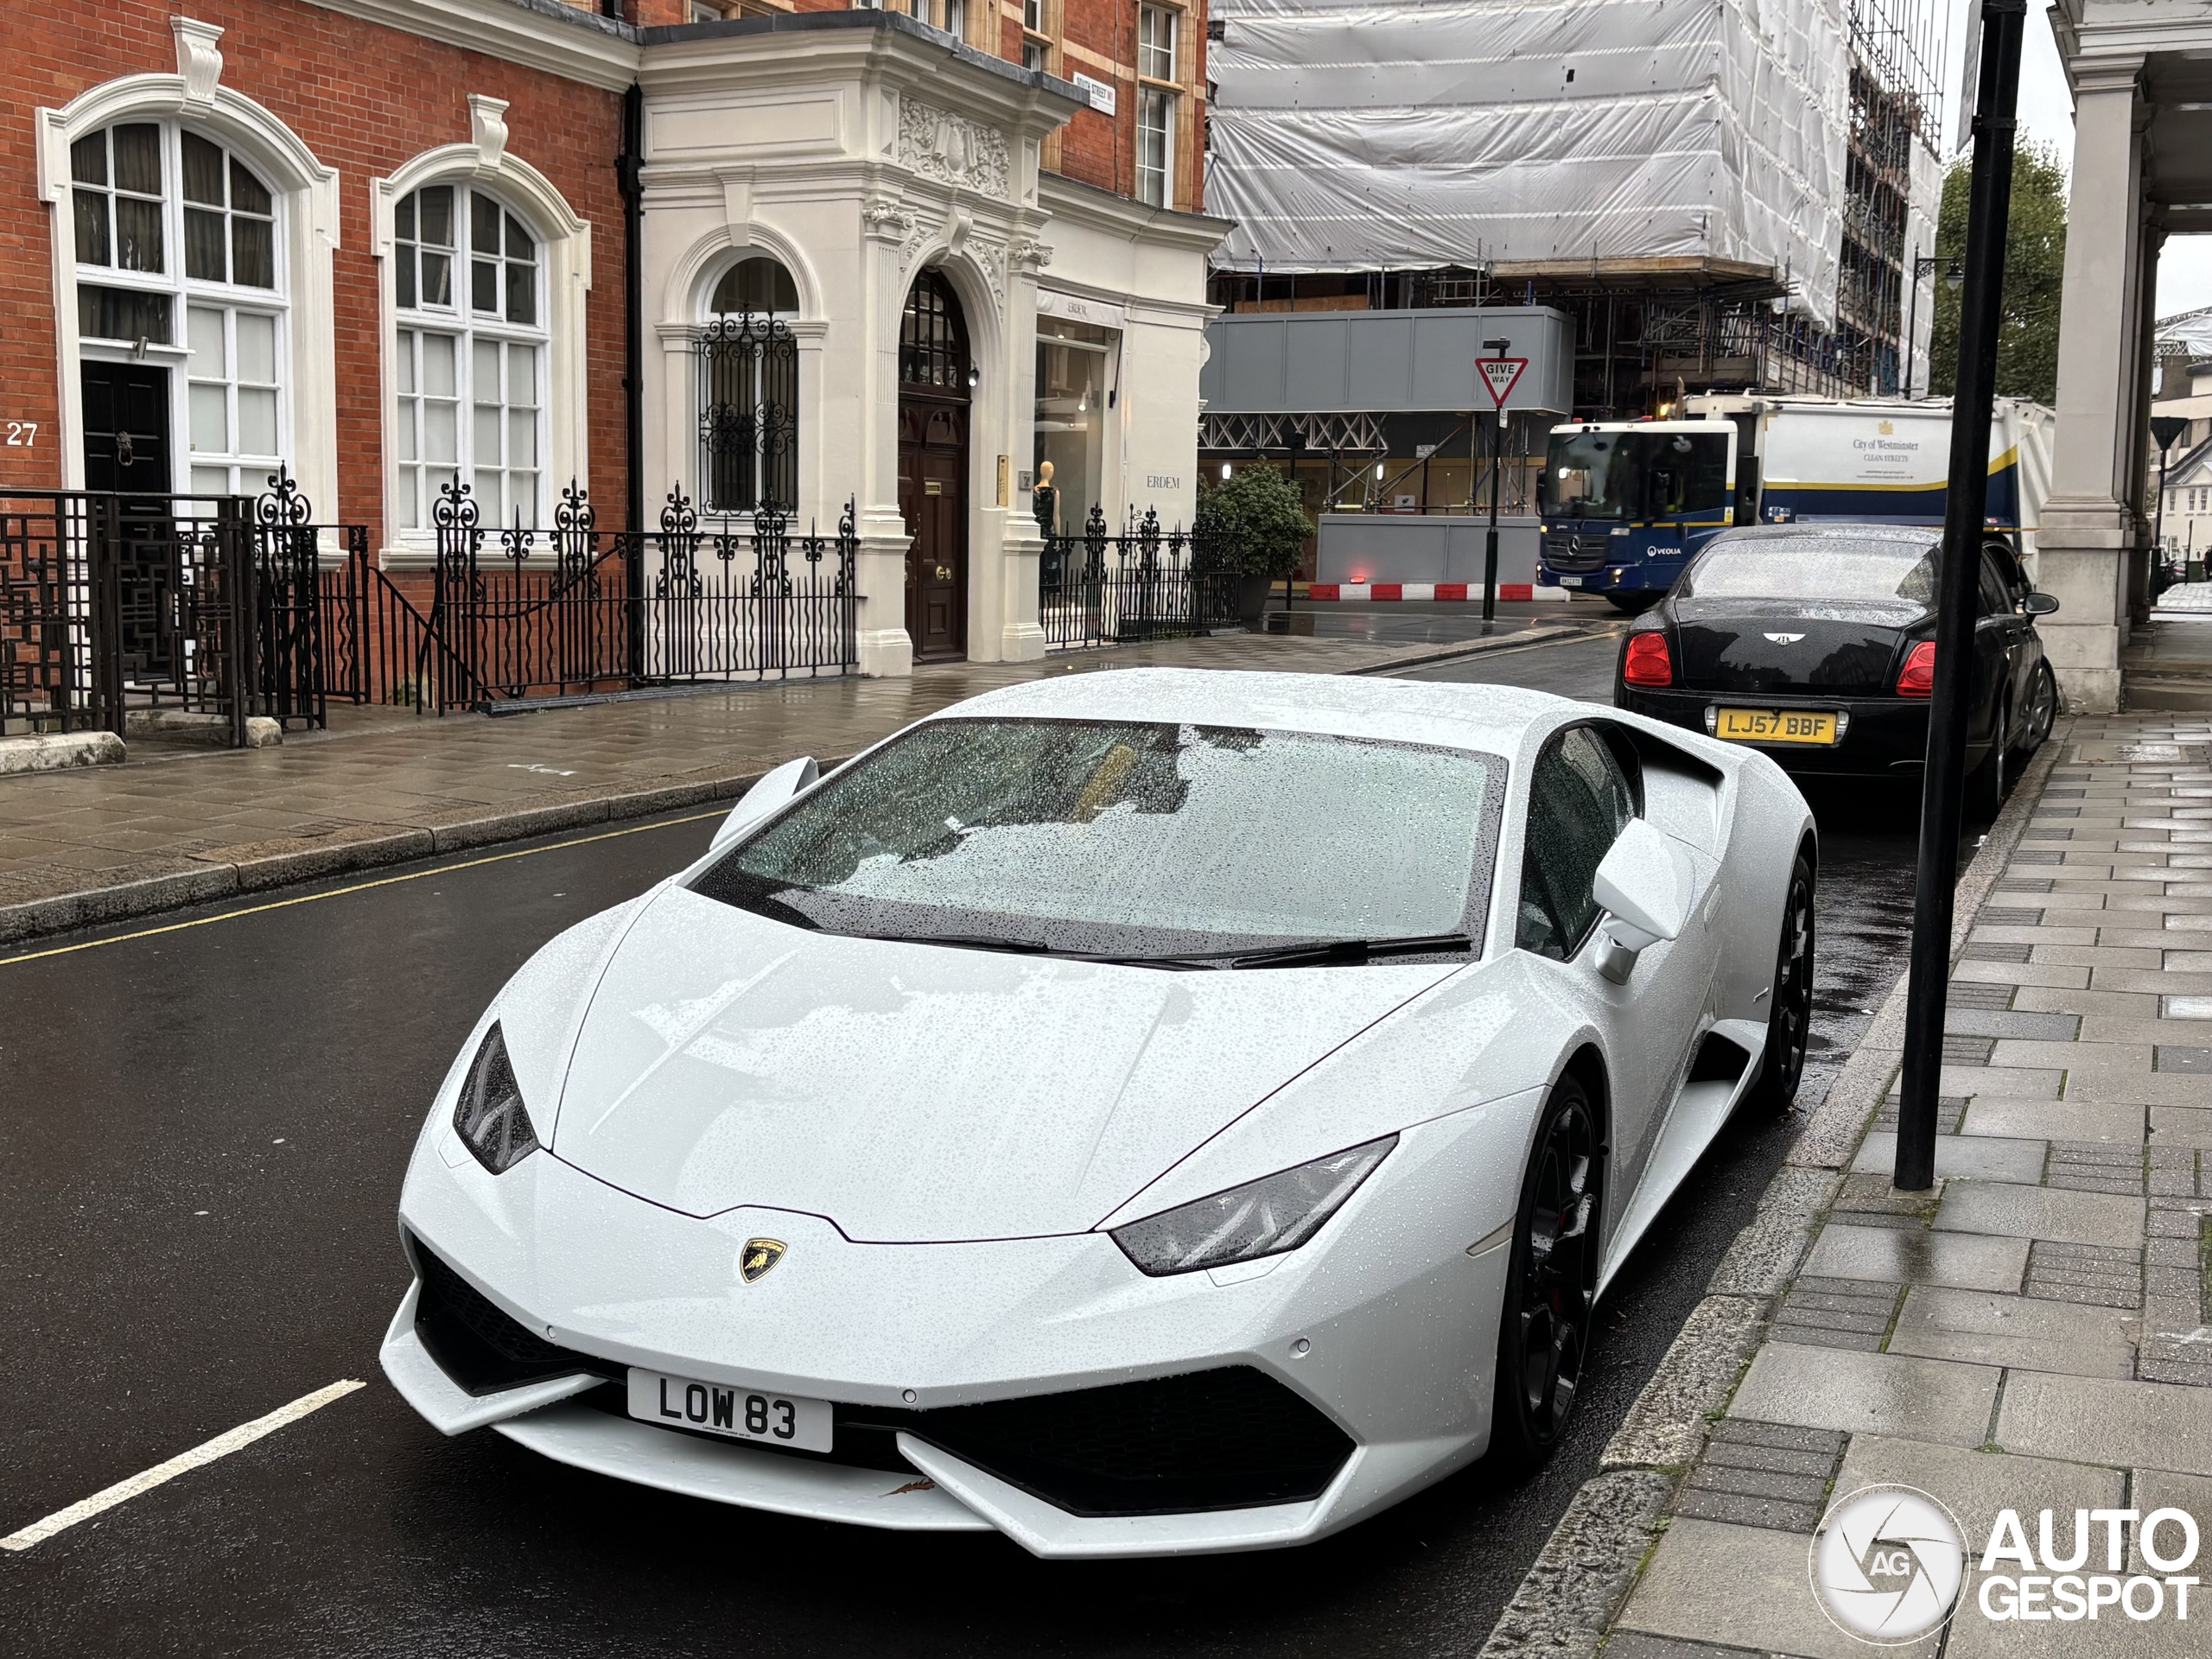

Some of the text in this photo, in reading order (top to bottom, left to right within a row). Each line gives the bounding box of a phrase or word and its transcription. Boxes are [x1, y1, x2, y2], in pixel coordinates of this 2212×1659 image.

[1092, 84, 1106, 99] STREET
[1485, 364, 1516, 374] GIVE
[7, 422, 38, 447] 27
[1853, 439, 1919, 451] City of Westminster
[1147, 475, 1179, 489] ERDEM
[1727, 715, 1827, 736] LJ57 BBF
[659, 1377, 796, 1440] LOW 83
